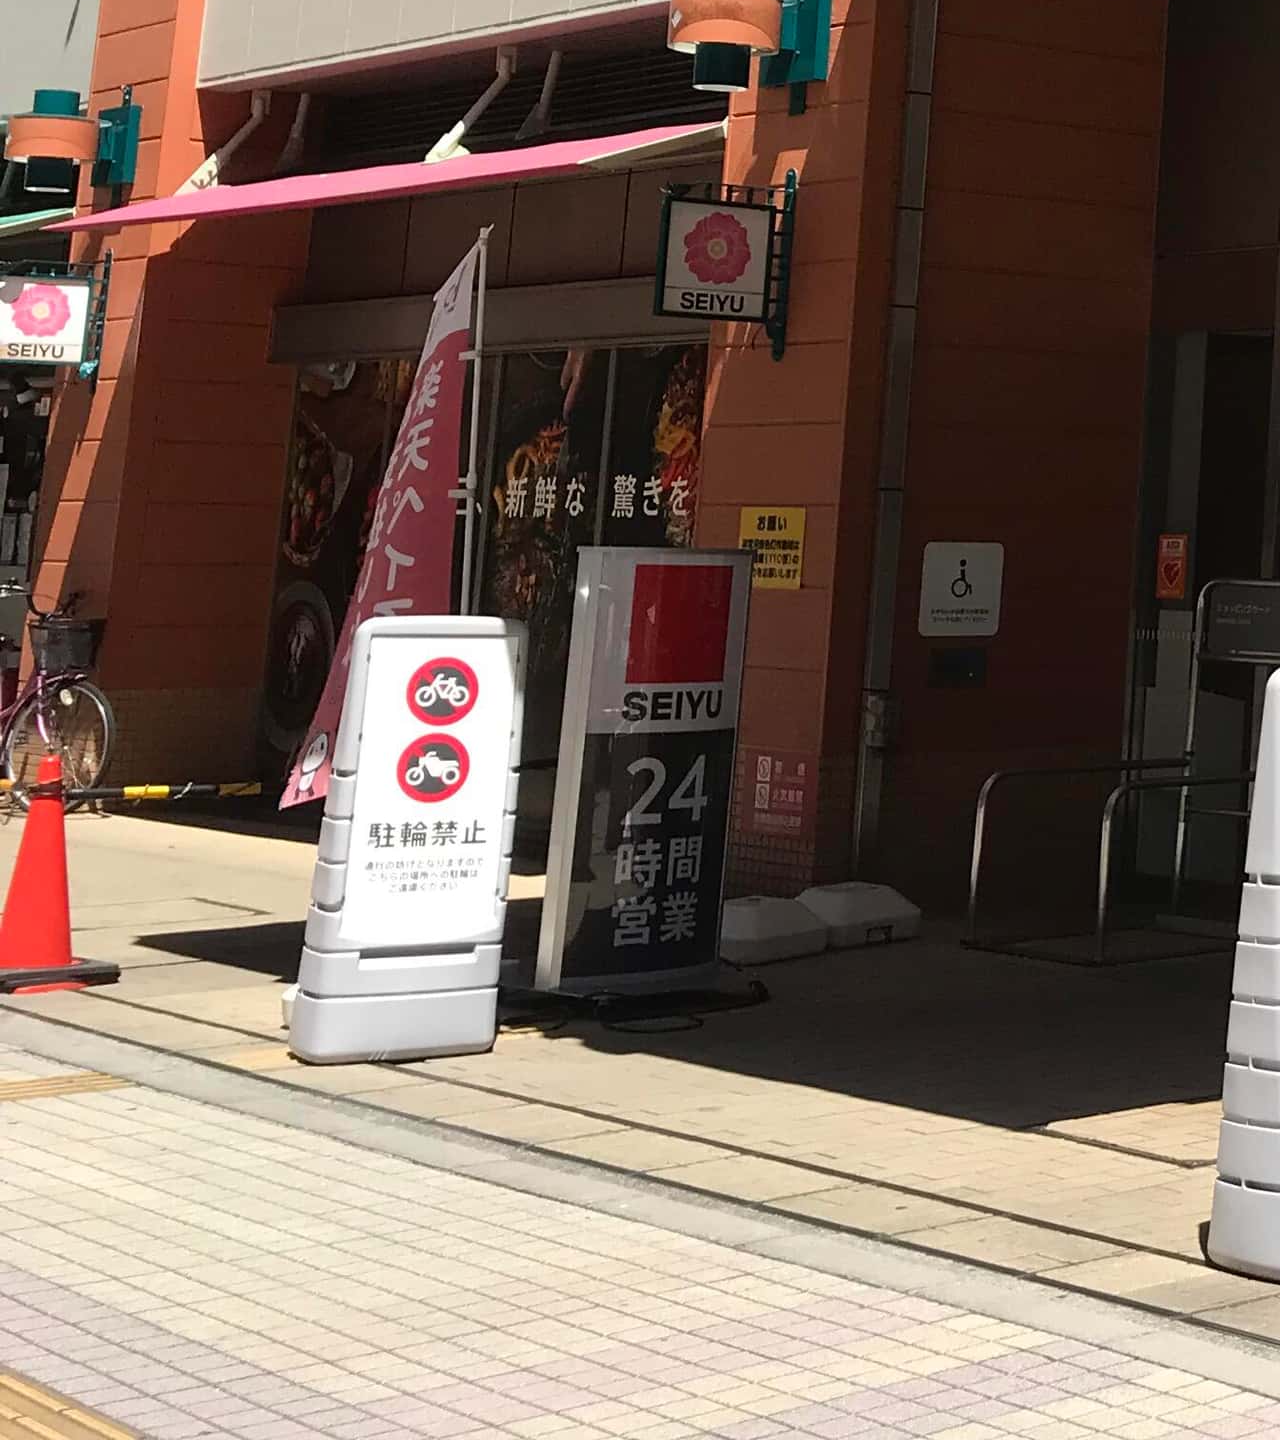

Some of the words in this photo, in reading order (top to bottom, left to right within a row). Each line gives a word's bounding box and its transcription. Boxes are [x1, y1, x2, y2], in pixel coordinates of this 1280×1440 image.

[680, 292, 745, 312] SEIYU
[7, 343, 64, 359] SEIYU
[504, 476, 586, 518] 新鮮な
[611, 474, 689, 518] 驚きを
[622, 690, 723, 722] SEIYU
[621, 754, 708, 825] 24
[367, 820, 487, 848] 駐輪禁止
[614, 835, 704, 888] 時間
[611, 891, 699, 947] 営業
